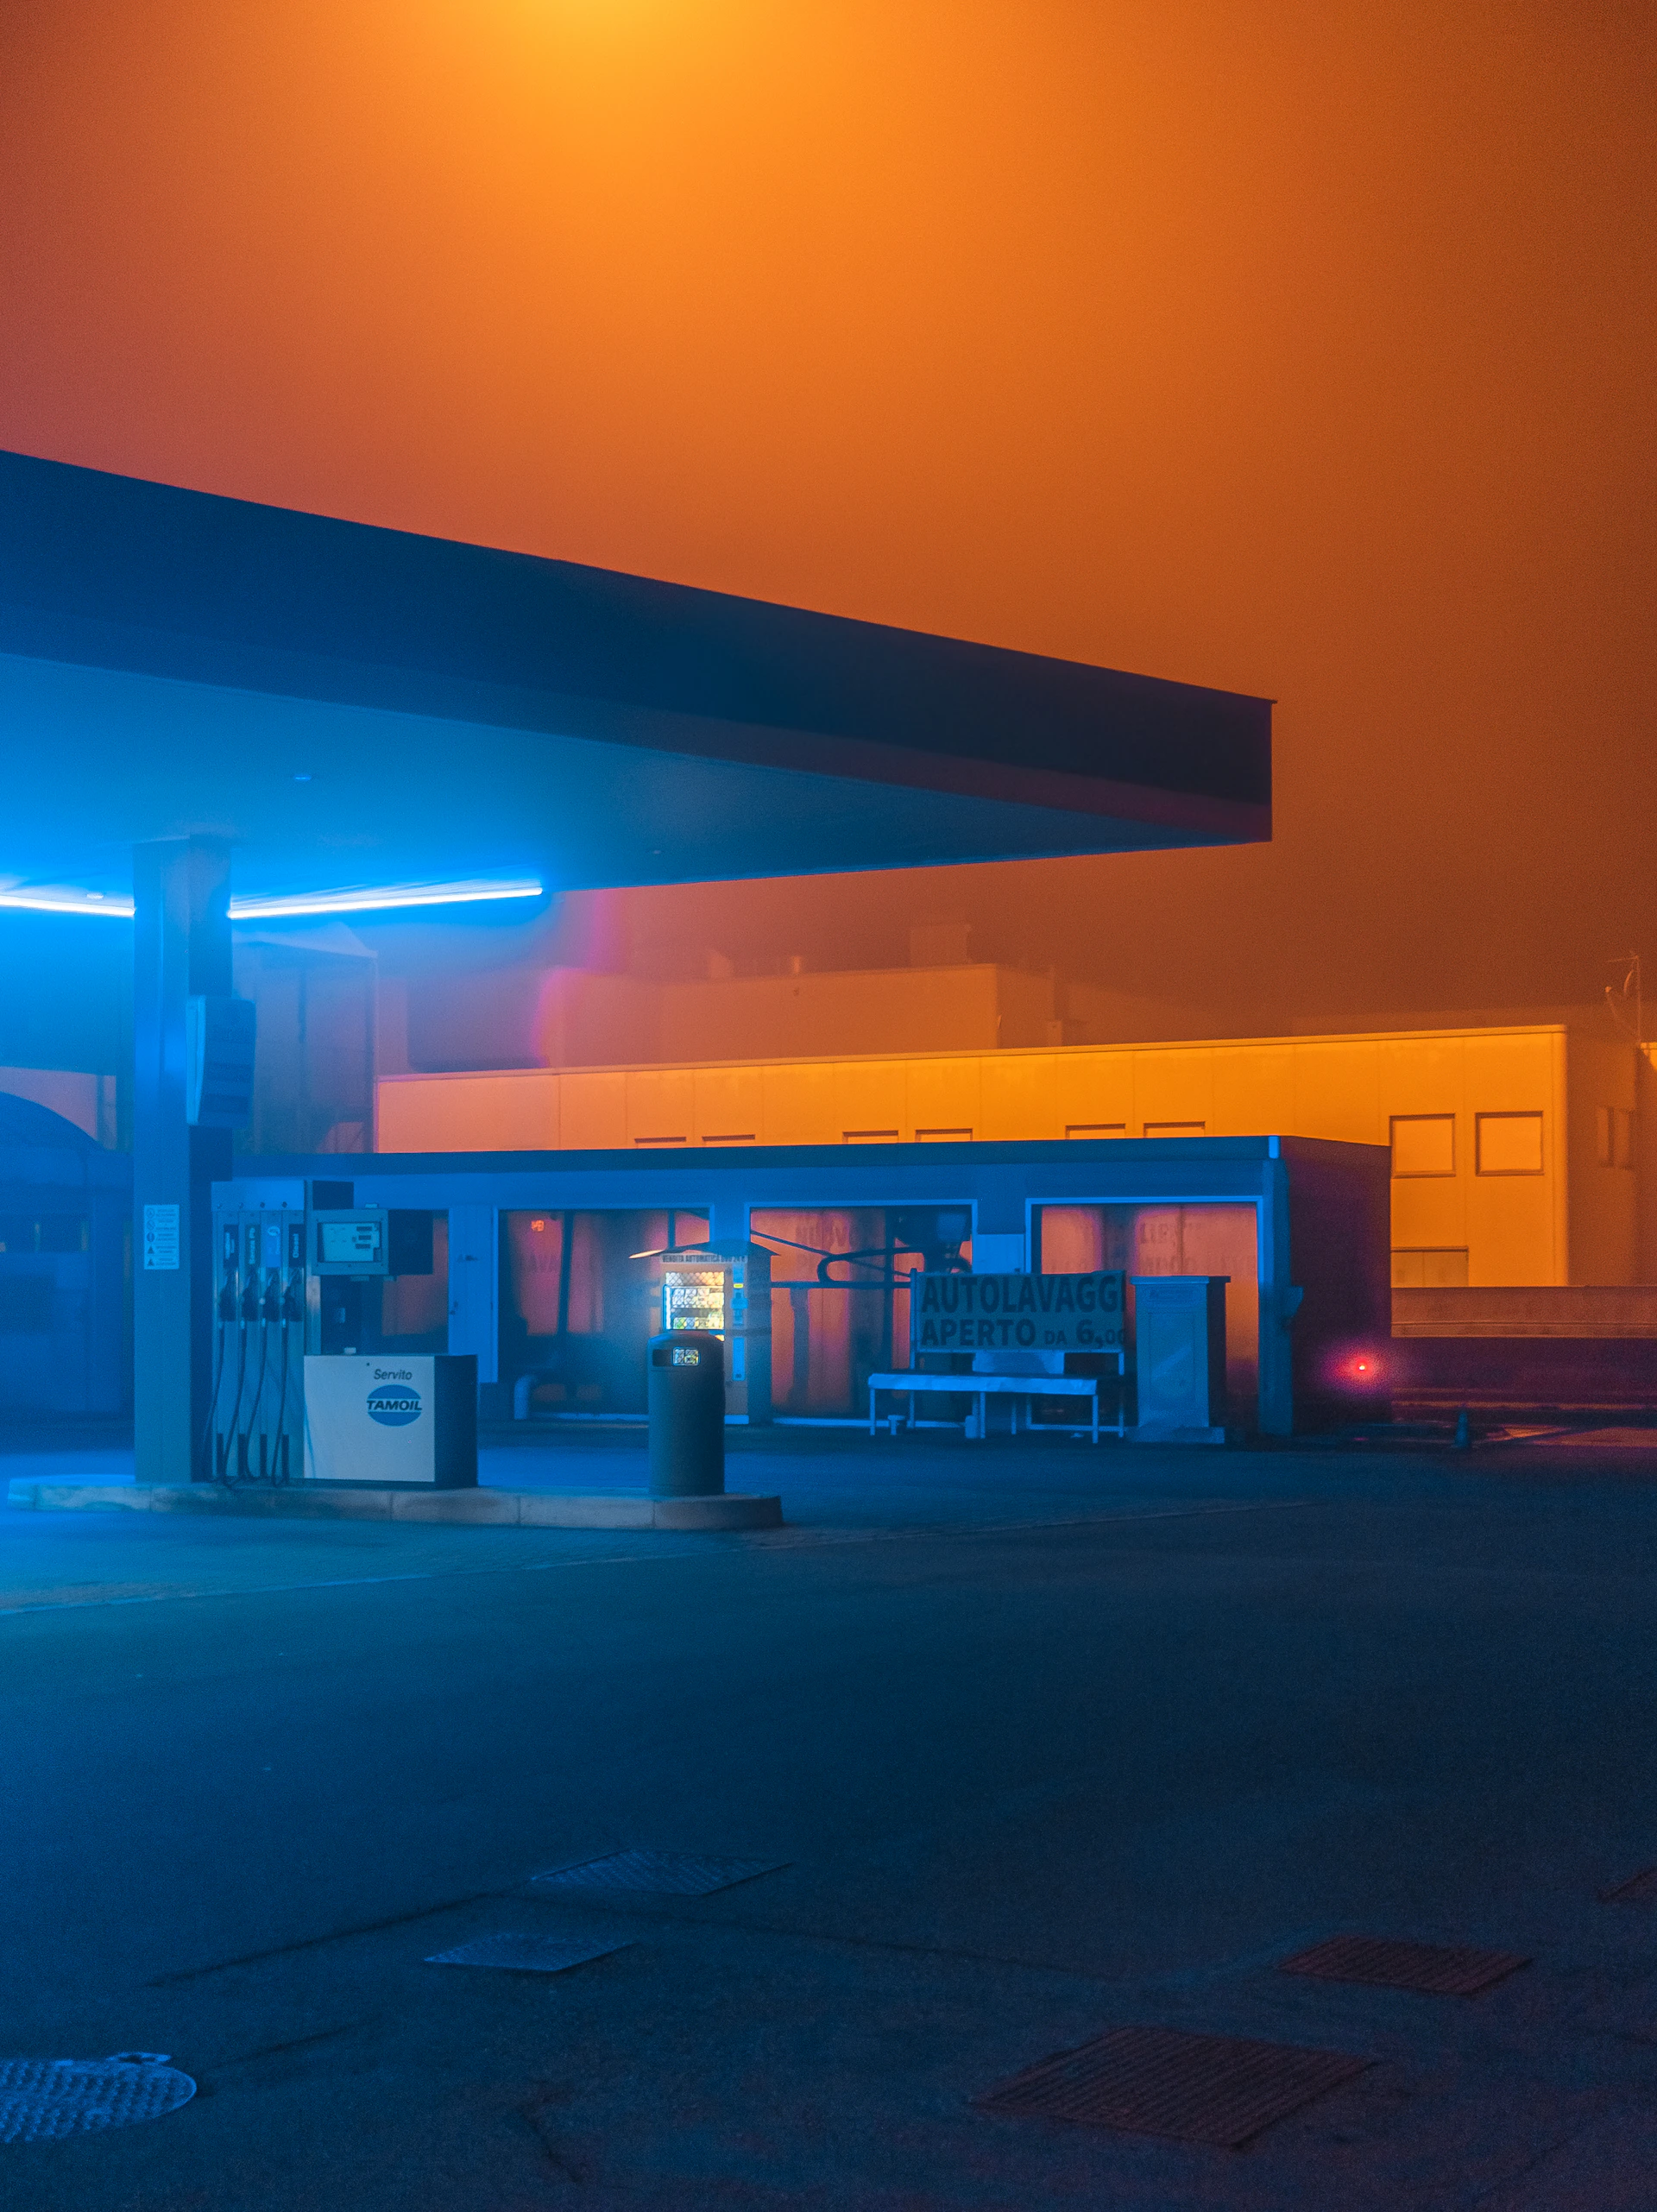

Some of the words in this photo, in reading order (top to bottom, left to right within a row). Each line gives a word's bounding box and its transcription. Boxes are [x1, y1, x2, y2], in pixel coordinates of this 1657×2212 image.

[920, 1318, 1036, 1347] APERTO
[1044, 1330, 1068, 1345] DA
[374, 1368, 413, 1381] Servito
[366, 1399, 423, 1412] TAMOIL
